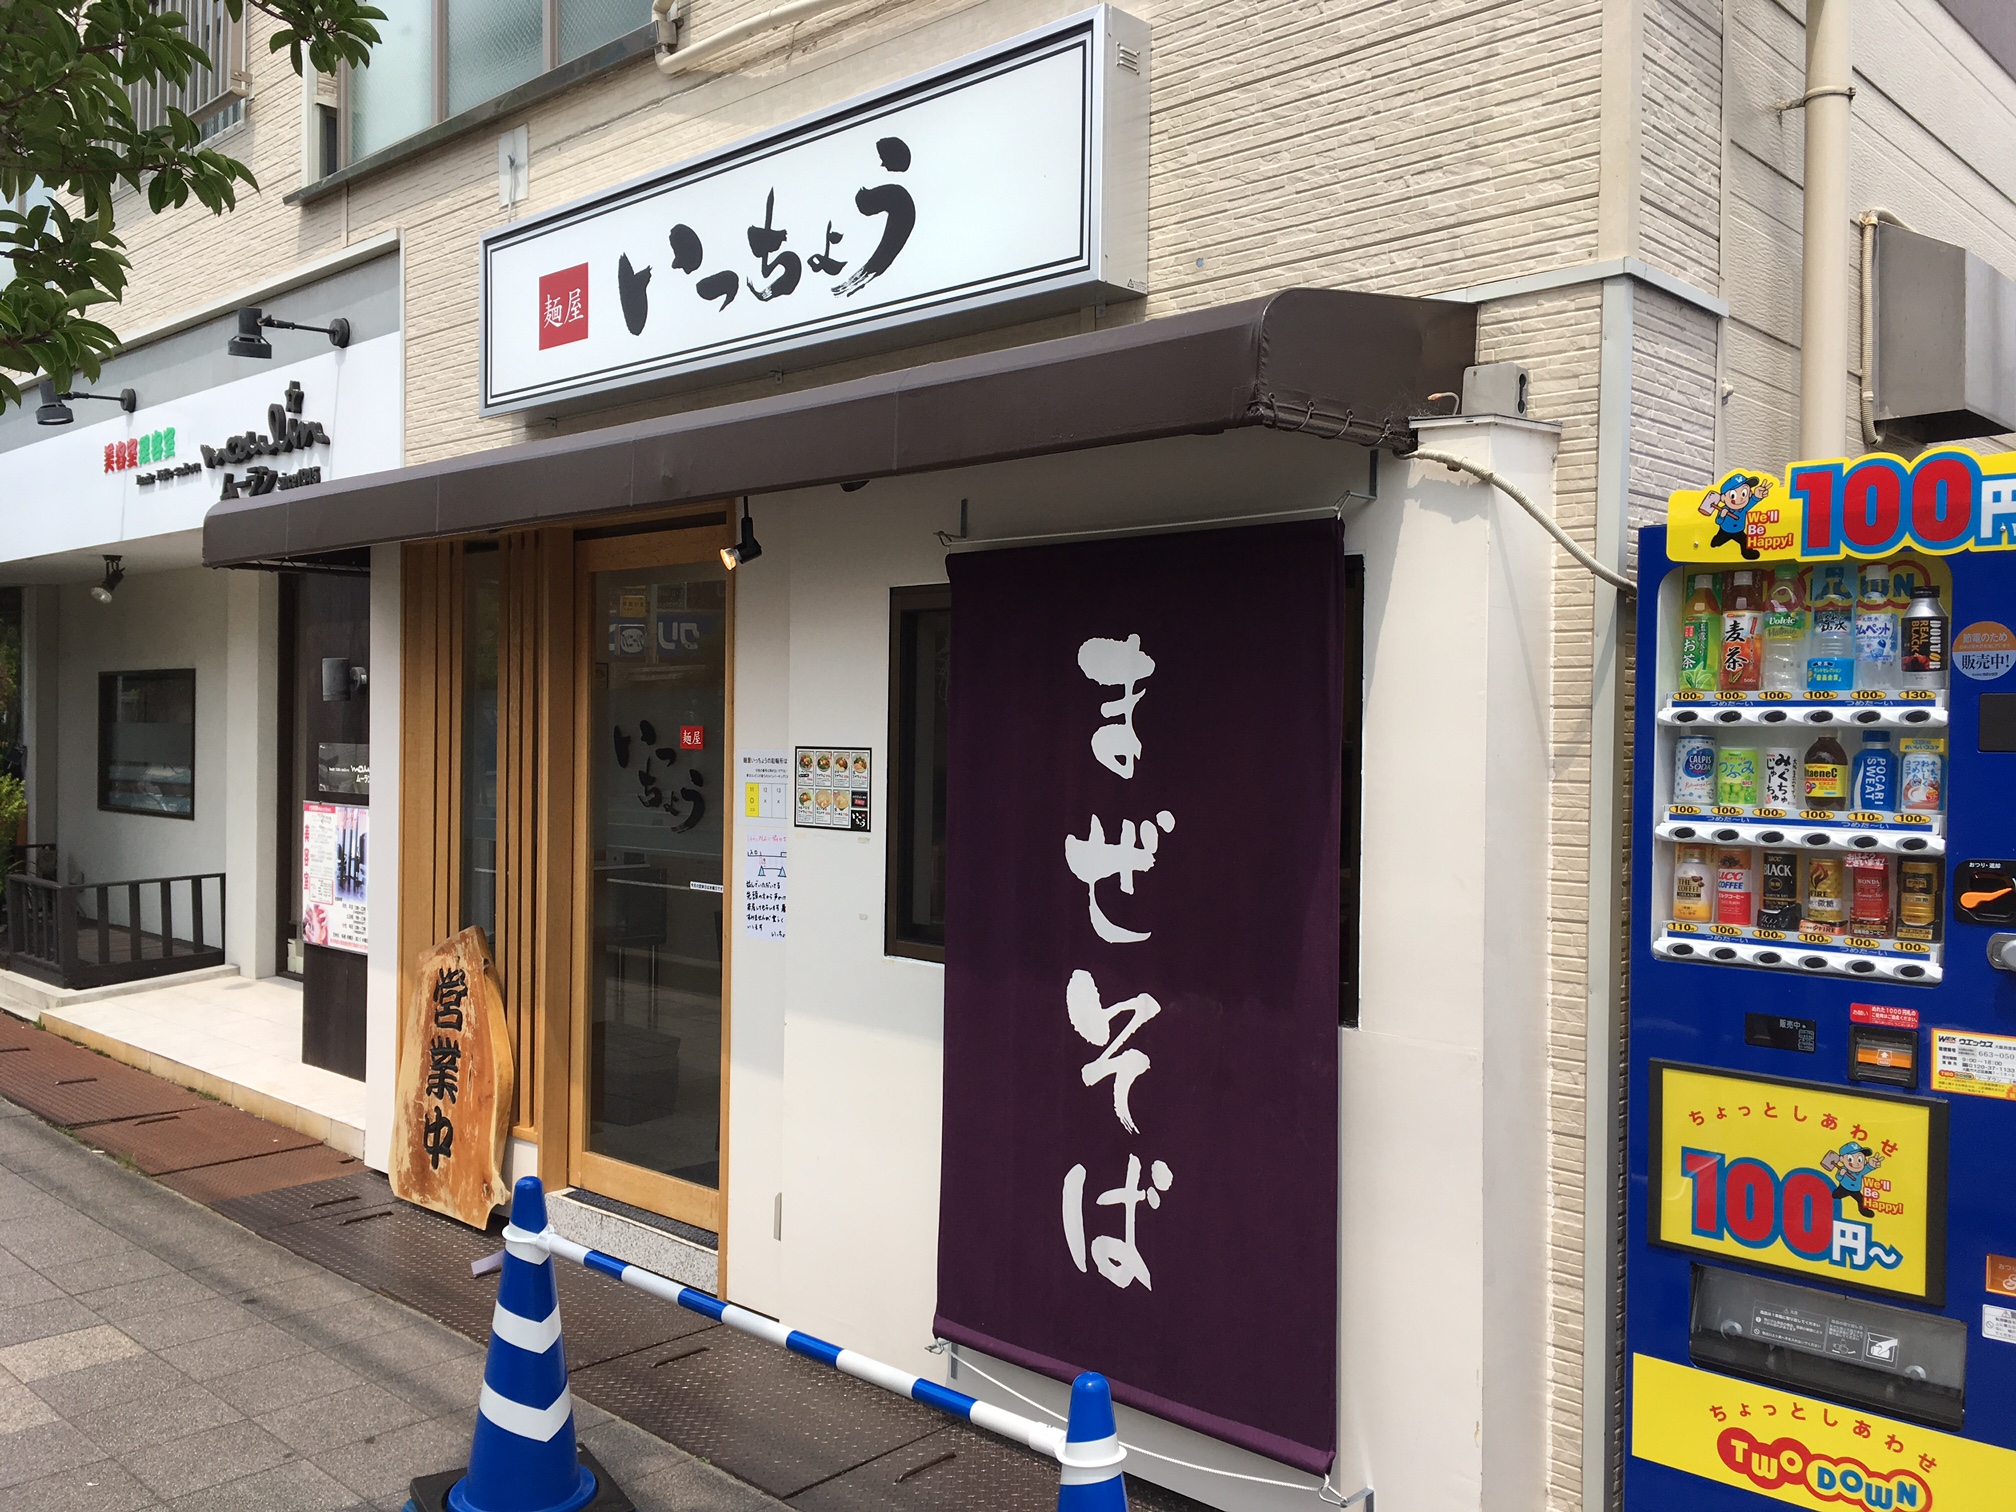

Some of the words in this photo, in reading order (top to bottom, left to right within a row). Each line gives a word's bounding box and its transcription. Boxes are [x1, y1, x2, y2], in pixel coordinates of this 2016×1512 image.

[617, 136, 916, 336] いっちょう
[543, 286, 584, 329] 麺屋
[1747, 510, 1778, 523] We'll
[1747, 533, 1792, 549] Happy!
[1748, 524, 1765, 535] Be
[1769, 617, 1796, 625] Volvic
[1919, 620, 1929, 644] REAL
[1725, 619, 1749, 671] 麦茶
[1911, 620, 1920, 652] BLACK
[1682, 639, 1696, 669] お茶
[681, 729, 702, 746] 麺屋
[1689, 755, 1712, 764] CALPIS
[1689, 763, 1711, 771] SODA
[1774, 753, 1791, 804] みっくちゅ
[1865, 757, 1876, 801] SWEAT
[1874, 758, 1887, 805] POCARI
[1920, 760, 1930, 787] おいしく
[1764, 864, 1792, 877] BLACK
[1061, 633, 1176, 1292] まぜそば
[1779, 1018, 1800, 1030] 販売中
[1688, 1101, 1899, 1158] ちょっとしあわせ
[1863, 1177, 1890, 1191] We'll
[1864, 1188, 1879, 1199] Be
[1863, 1197, 1903, 1214] Happy!
[1709, 1402, 1937, 1474] ちょっとしあわせ
[1730, 1439, 1803, 1480] TWO
[1816, 1466, 1918, 1510] DOWN
